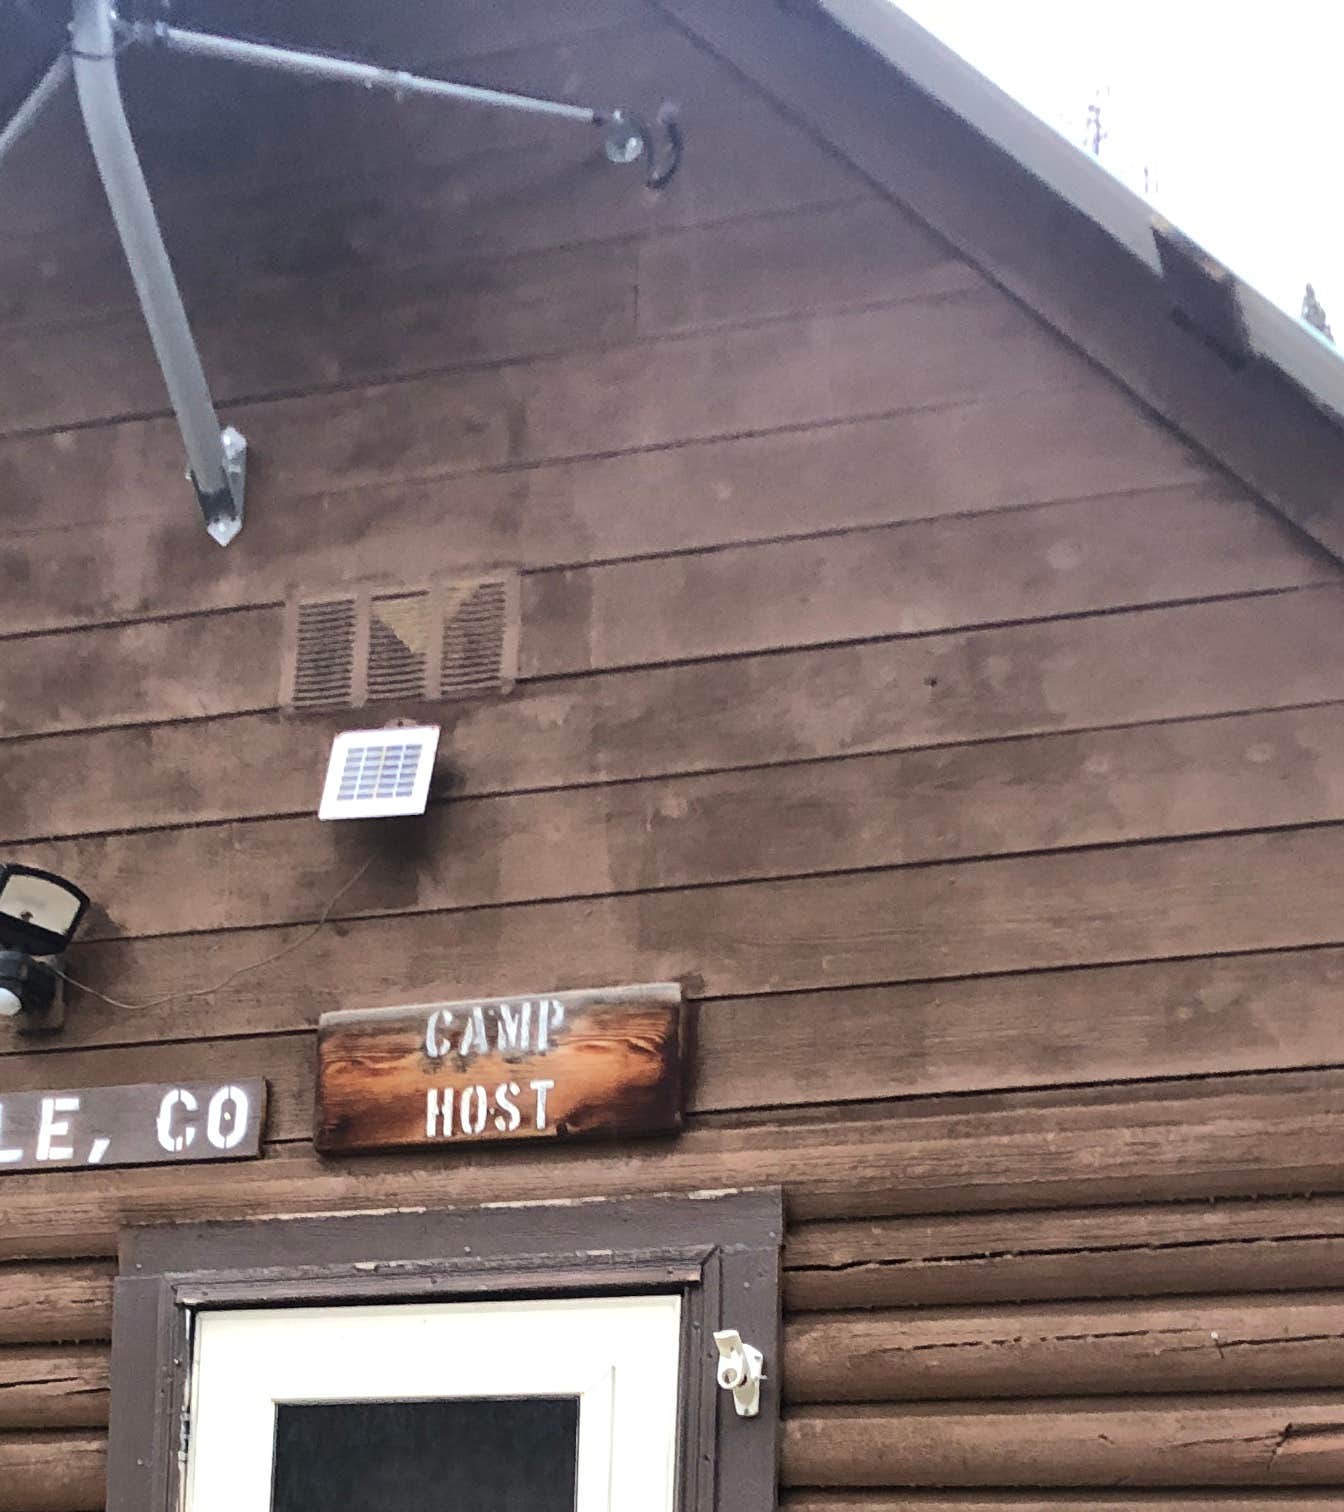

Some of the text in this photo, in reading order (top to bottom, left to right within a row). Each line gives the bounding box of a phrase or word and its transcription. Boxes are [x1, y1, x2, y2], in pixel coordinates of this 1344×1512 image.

[425, 999, 567, 1058] CAMP
[155, 1084, 250, 1153] CO
[425, 1078, 556, 1138] HOST
